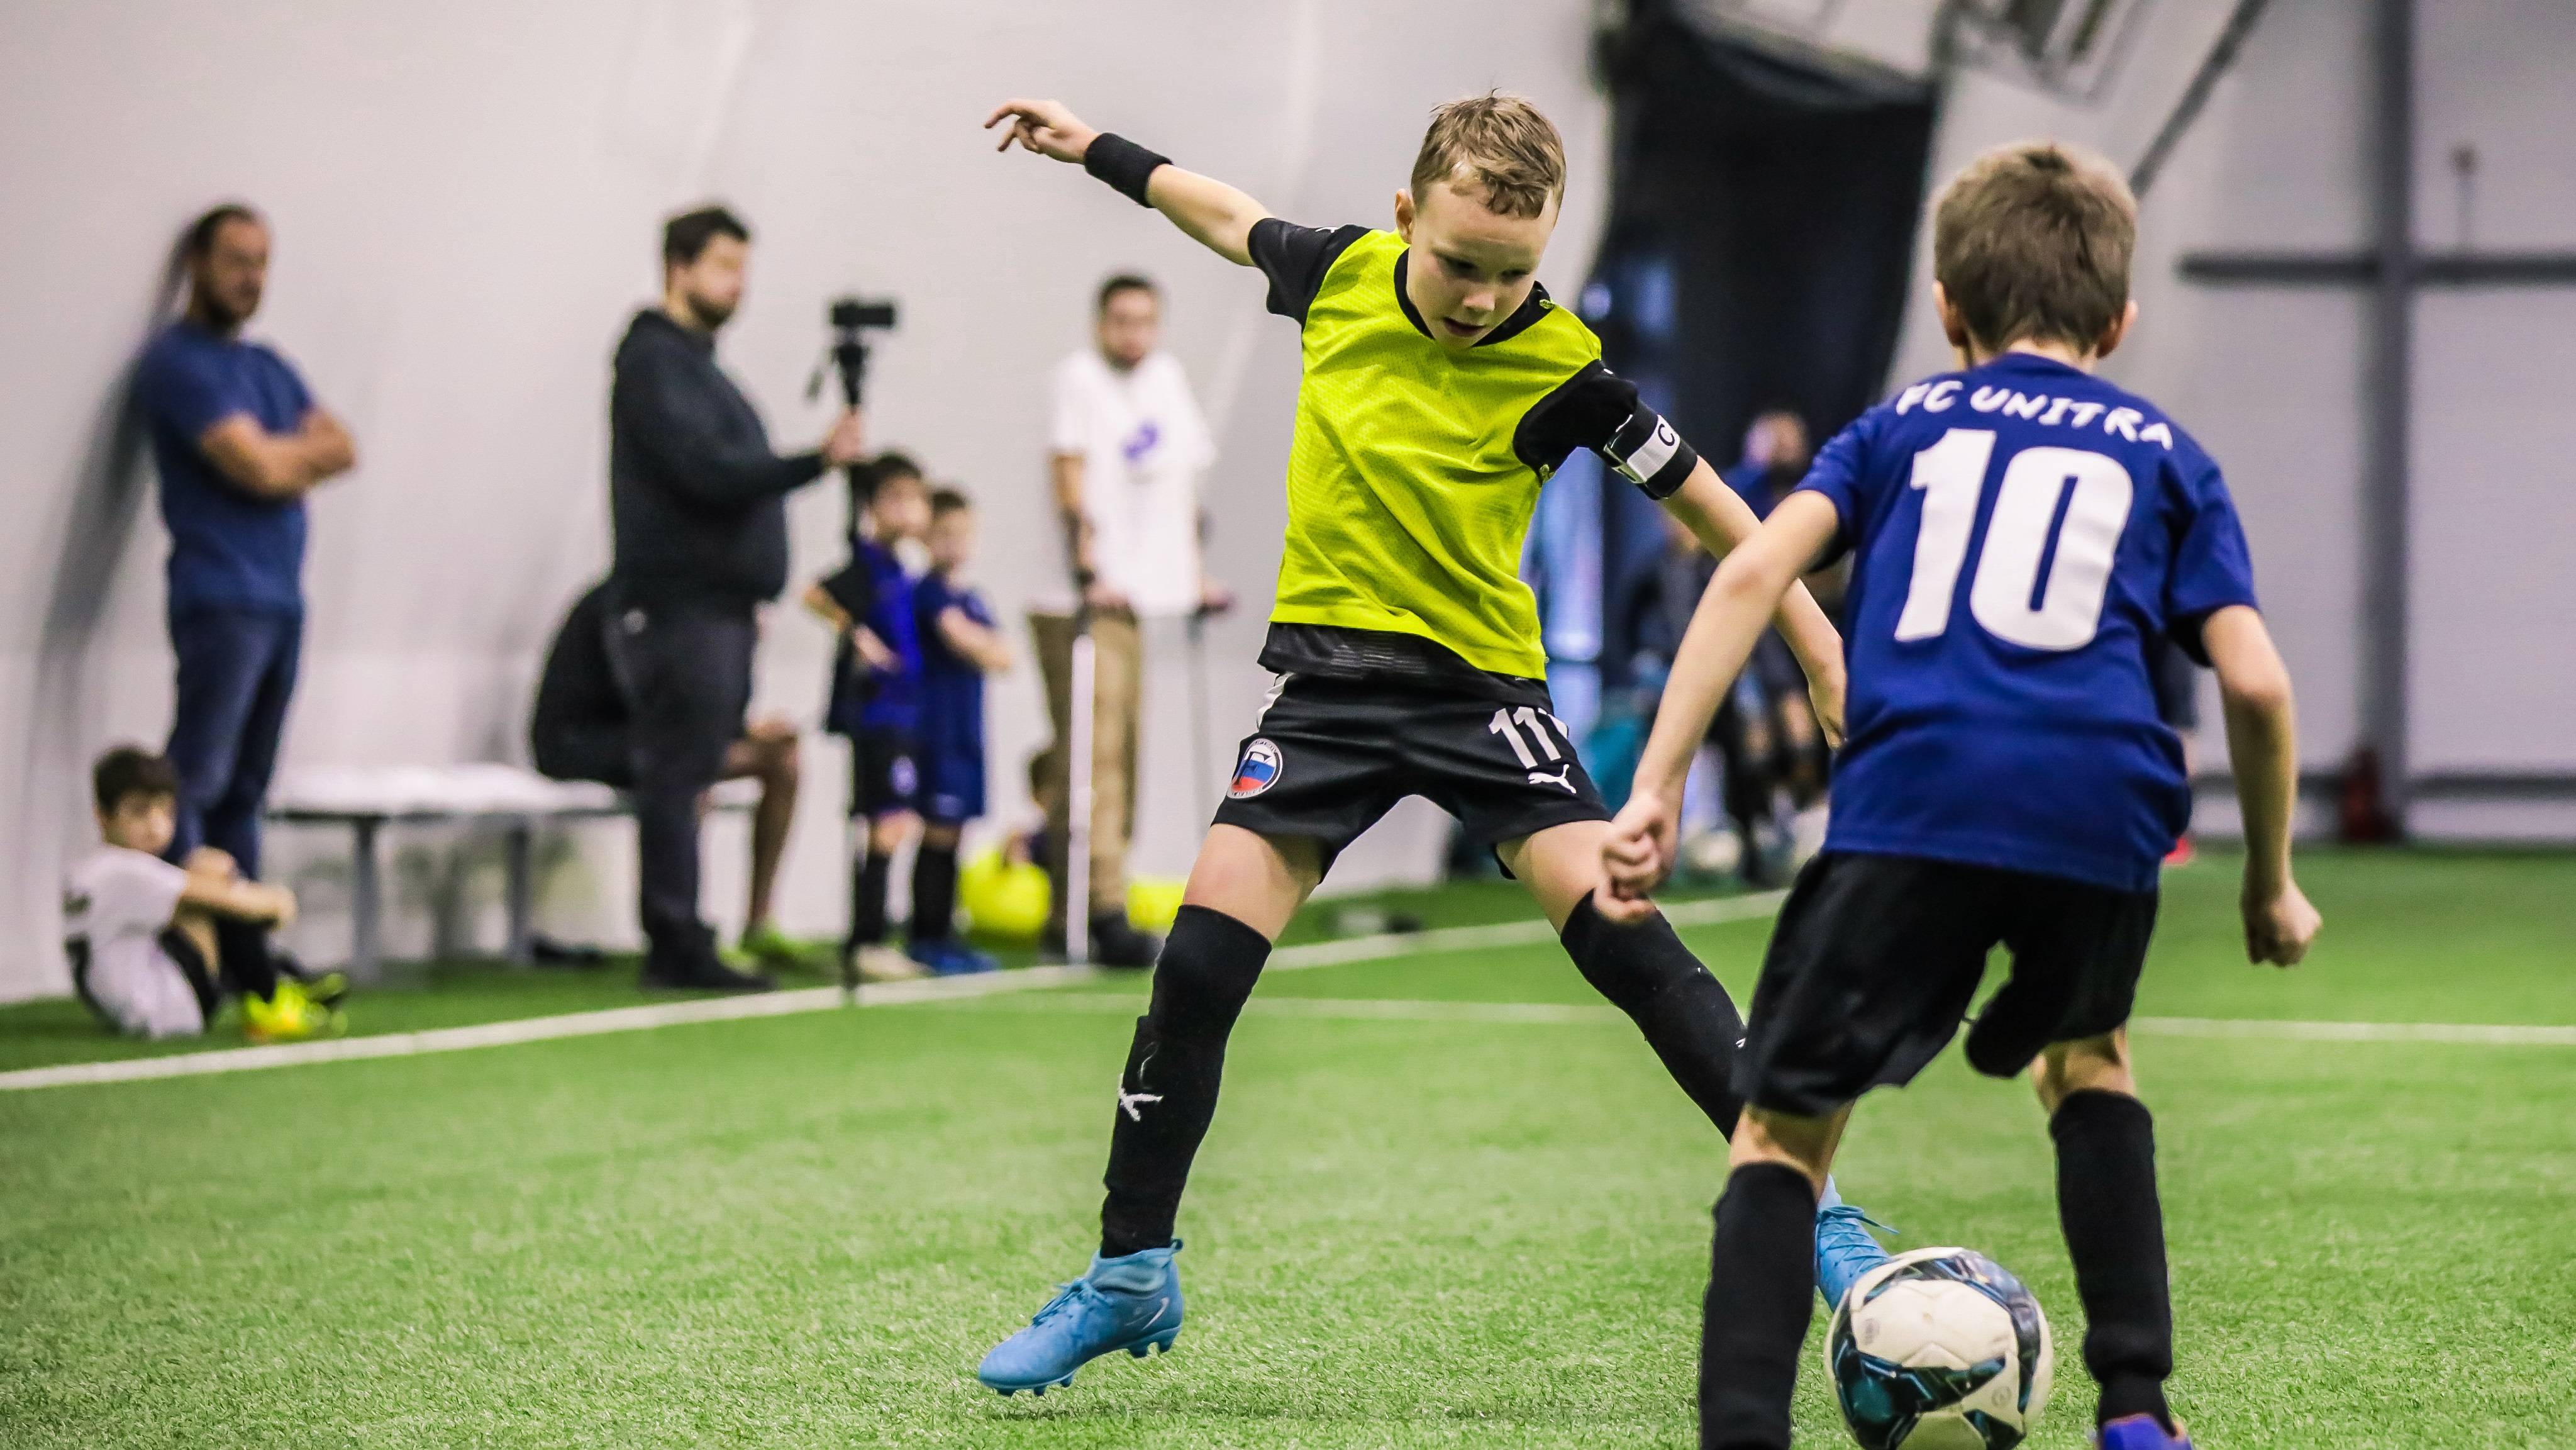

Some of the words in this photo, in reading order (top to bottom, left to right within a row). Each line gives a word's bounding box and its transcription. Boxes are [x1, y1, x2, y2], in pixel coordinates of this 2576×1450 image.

[1658, 423, 1675, 447] C
[1896, 380, 1963, 415] FC
[1970, 385, 2174, 450] UNITRA
[1894, 428, 2133, 652] 10
[1488, 706, 1562, 769] 11
